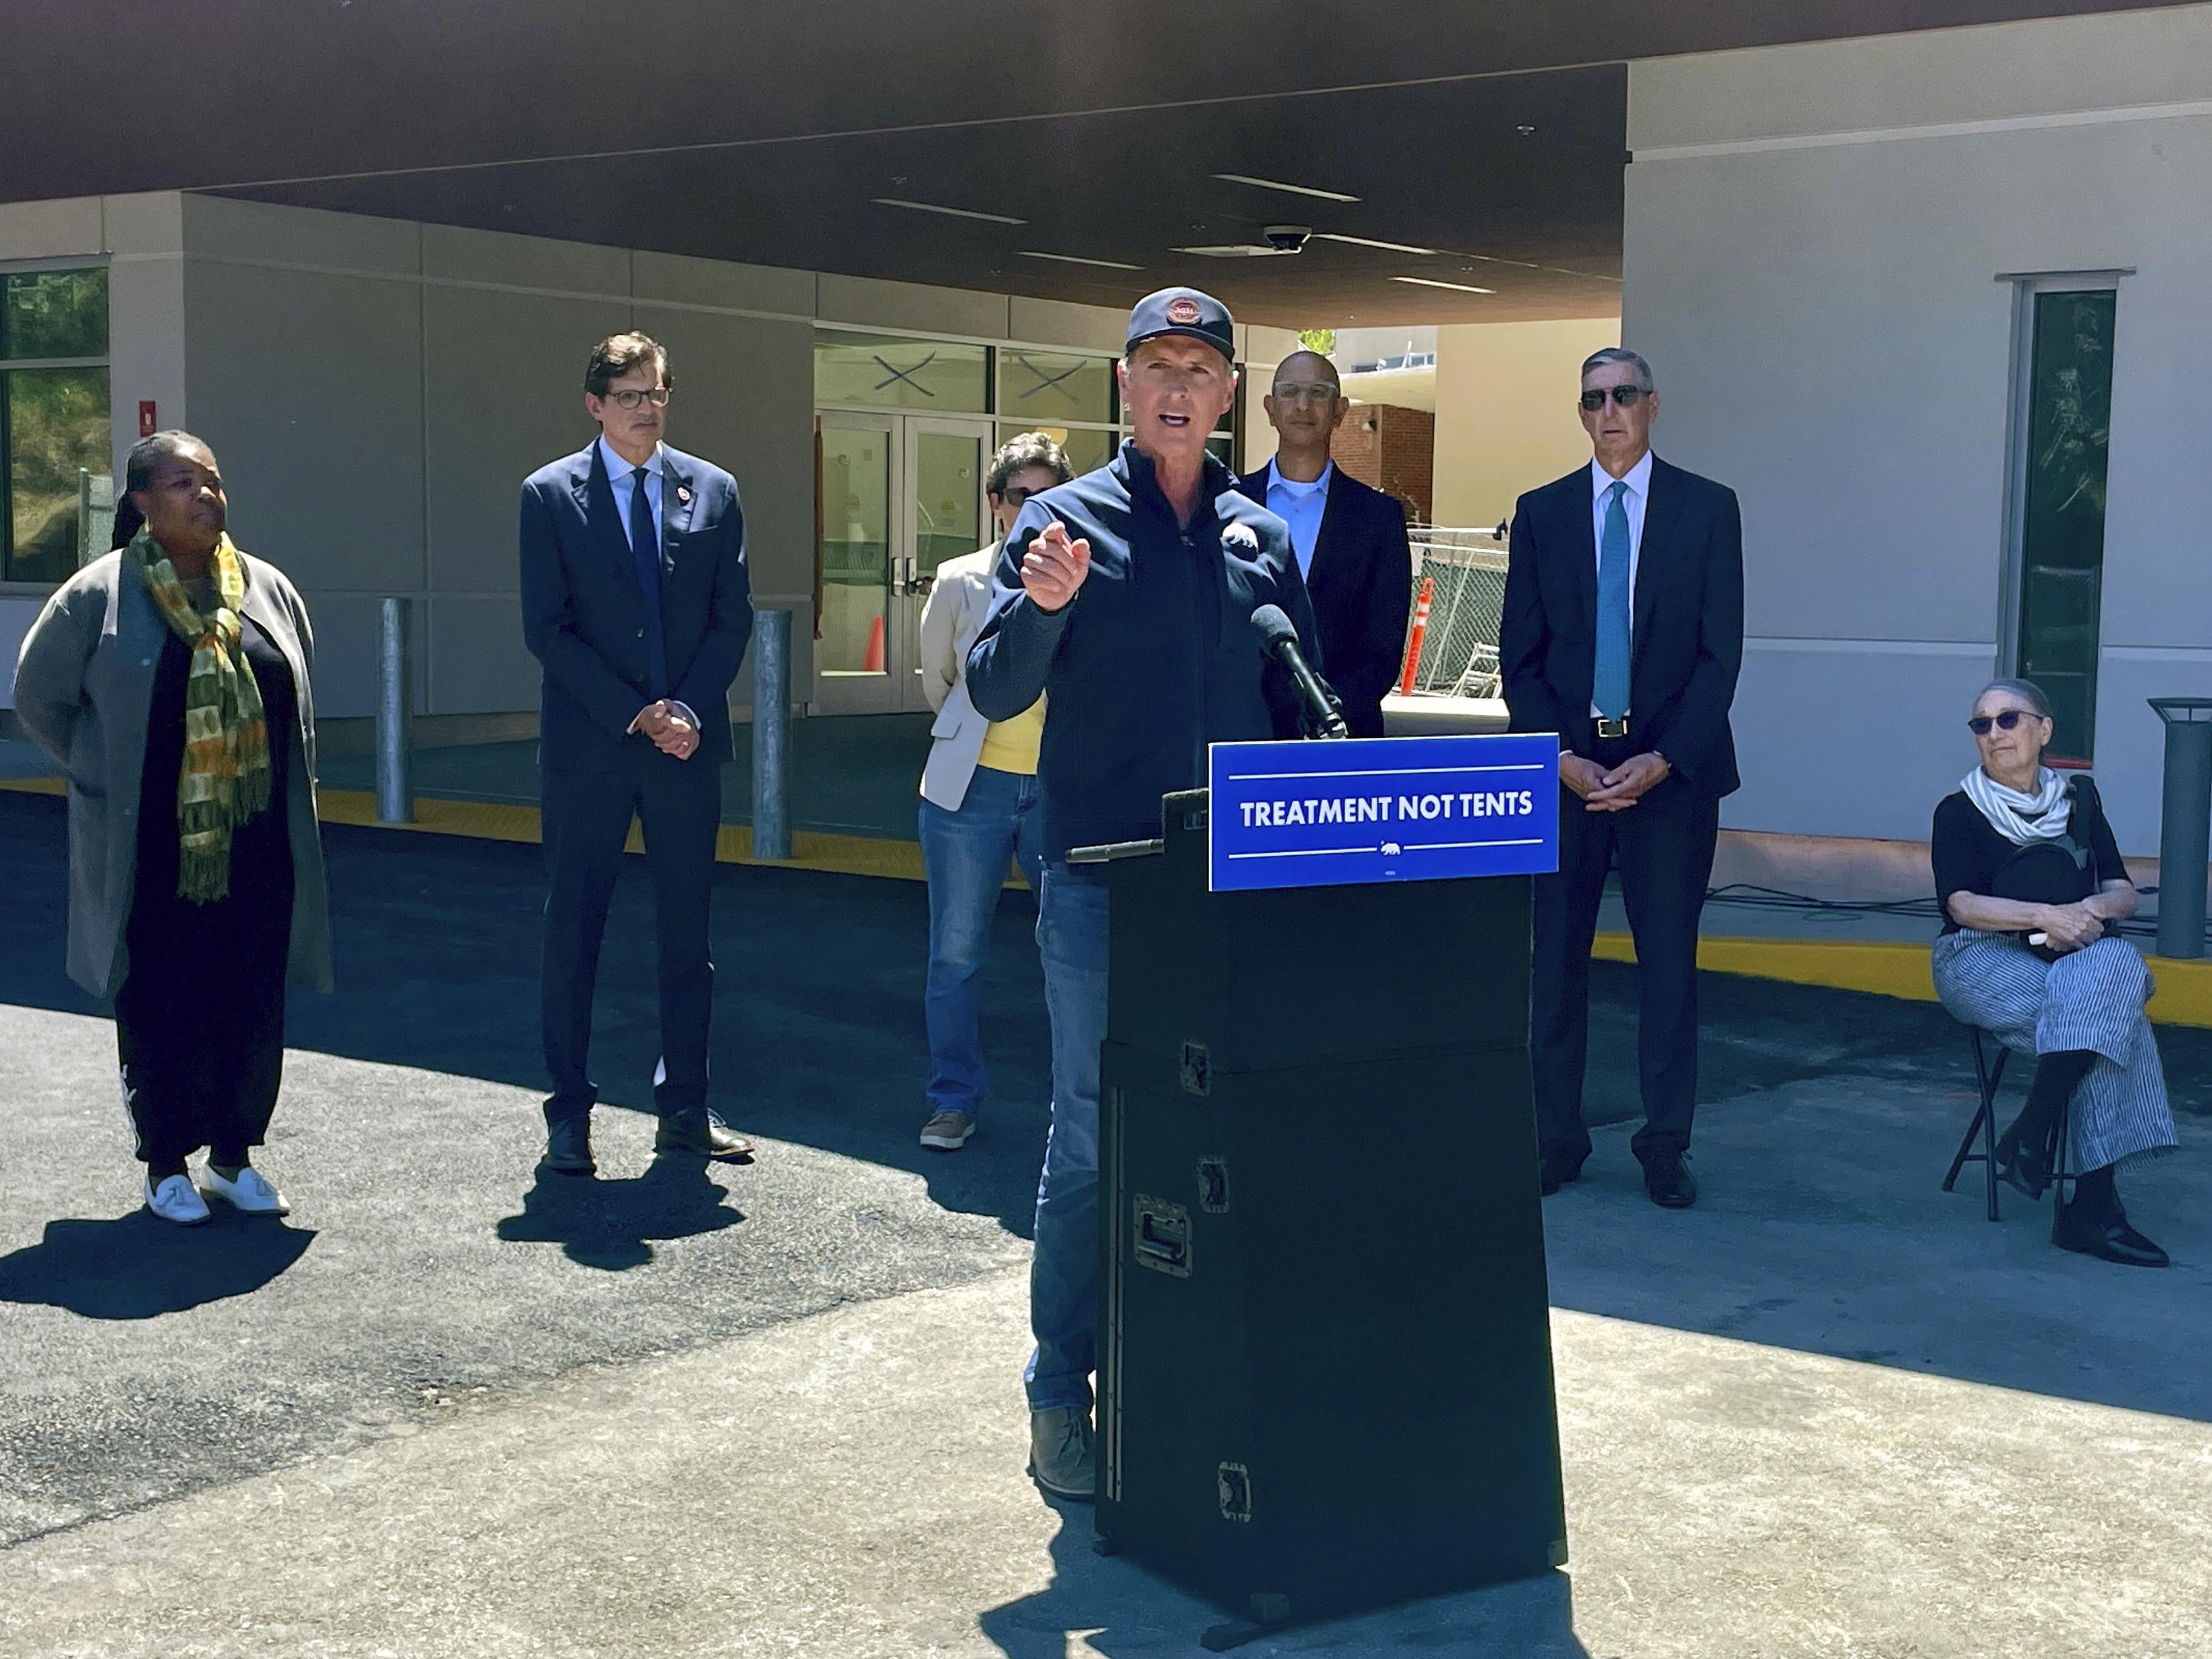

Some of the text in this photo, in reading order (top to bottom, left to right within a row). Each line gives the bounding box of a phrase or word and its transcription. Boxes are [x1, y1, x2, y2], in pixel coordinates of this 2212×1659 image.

[1240, 790, 1532, 827] TREATMENT NOT TENTS
